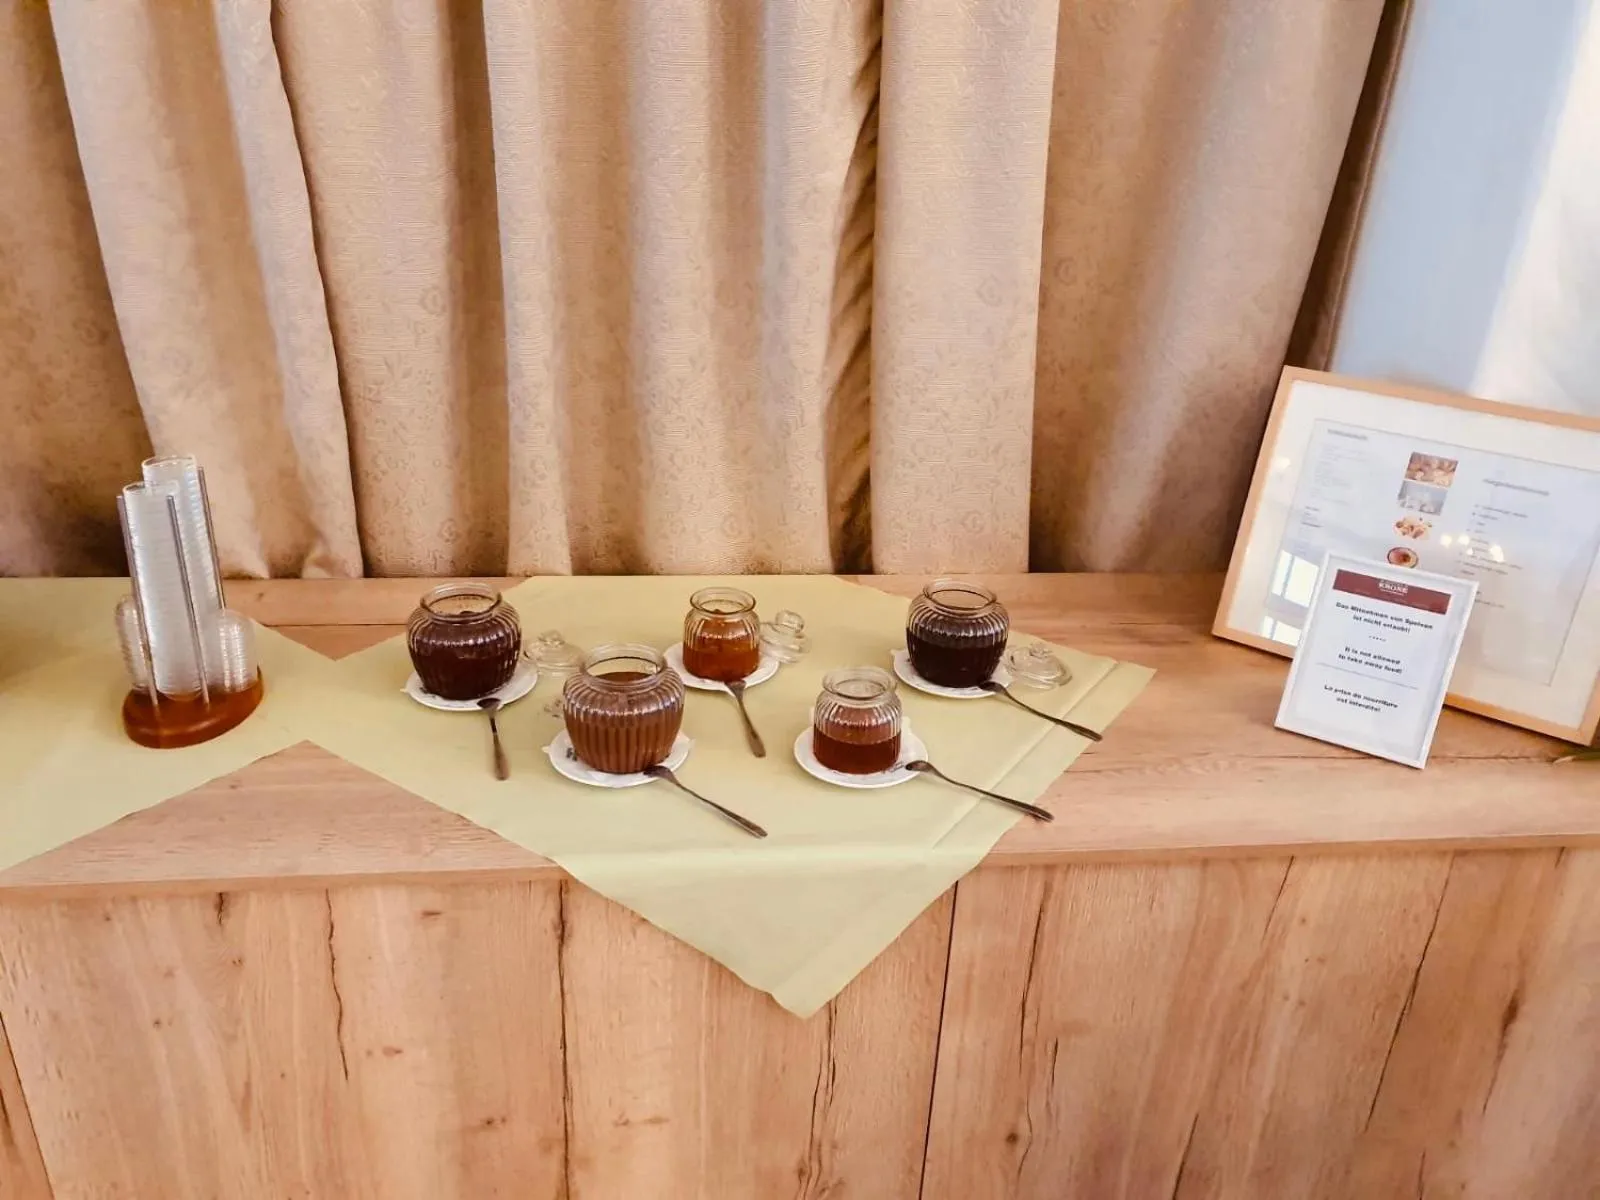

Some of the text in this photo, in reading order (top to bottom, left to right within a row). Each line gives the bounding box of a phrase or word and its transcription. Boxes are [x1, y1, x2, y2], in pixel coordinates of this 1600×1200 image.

[1350, 605, 1388, 619] Mitnehmen
[1405, 618, 1433, 629] Speisen
[1363, 617, 1381, 626] nicht
[1383, 622, 1410, 634] erlaubt!
[1347, 656, 1362, 664] take
[1364, 661, 1383, 670] away
[1384, 665, 1402, 674] food!
[1373, 654, 1400, 665] allowed
[1334, 687, 1351, 696] prise
[1363, 695, 1398, 708] nourriture
